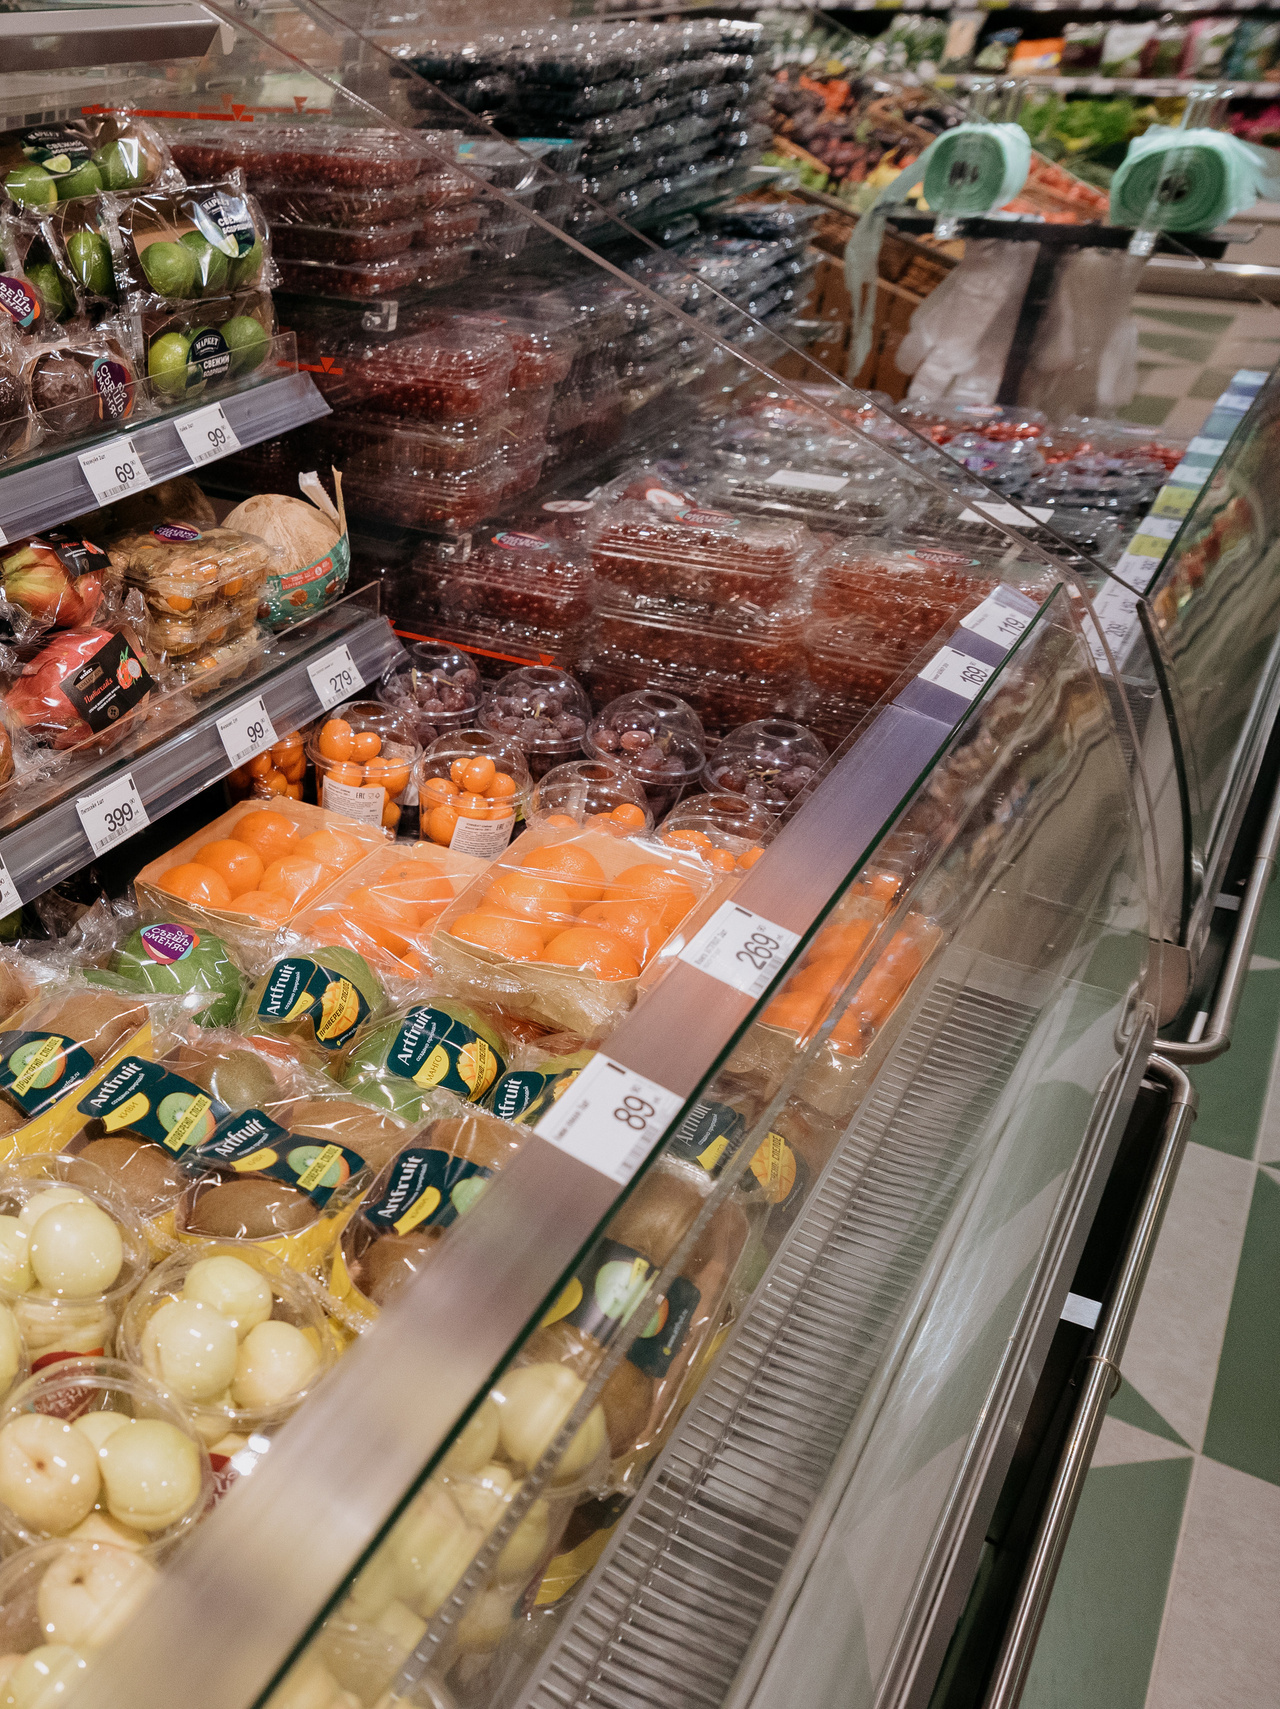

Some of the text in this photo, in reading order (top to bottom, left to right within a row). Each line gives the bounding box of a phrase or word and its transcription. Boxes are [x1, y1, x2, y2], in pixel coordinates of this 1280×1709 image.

[194, 337, 219, 349] МАРКЕТ
[203, 355, 230, 369] СВЕЖИЙ
[207, 427, 226, 447] 99
[114, 462, 135, 483] 69
[996, 617, 1026, 636] 119
[329, 670, 353, 693] 279
[960, 665, 988, 686] 169
[247, 721, 264, 743] 99
[104, 803, 133, 832] 399
[149, 932, 180, 951] МЕНЯ
[151, 927, 190, 947] СЪЕШЬ
[736, 932, 780, 970] 269
[266, 964, 296, 1016] Artfruit
[396, 1010, 433, 1066] Artfruit
[425, 1054, 442, 1083] МАНГО
[90, 1061, 142, 1109] Artfruit
[118, 1101, 138, 1120] КИВИ
[613, 1095, 655, 1130] 89
[214, 1117, 266, 1157] Artfruit
[377, 1155, 425, 1219] Artfruit
